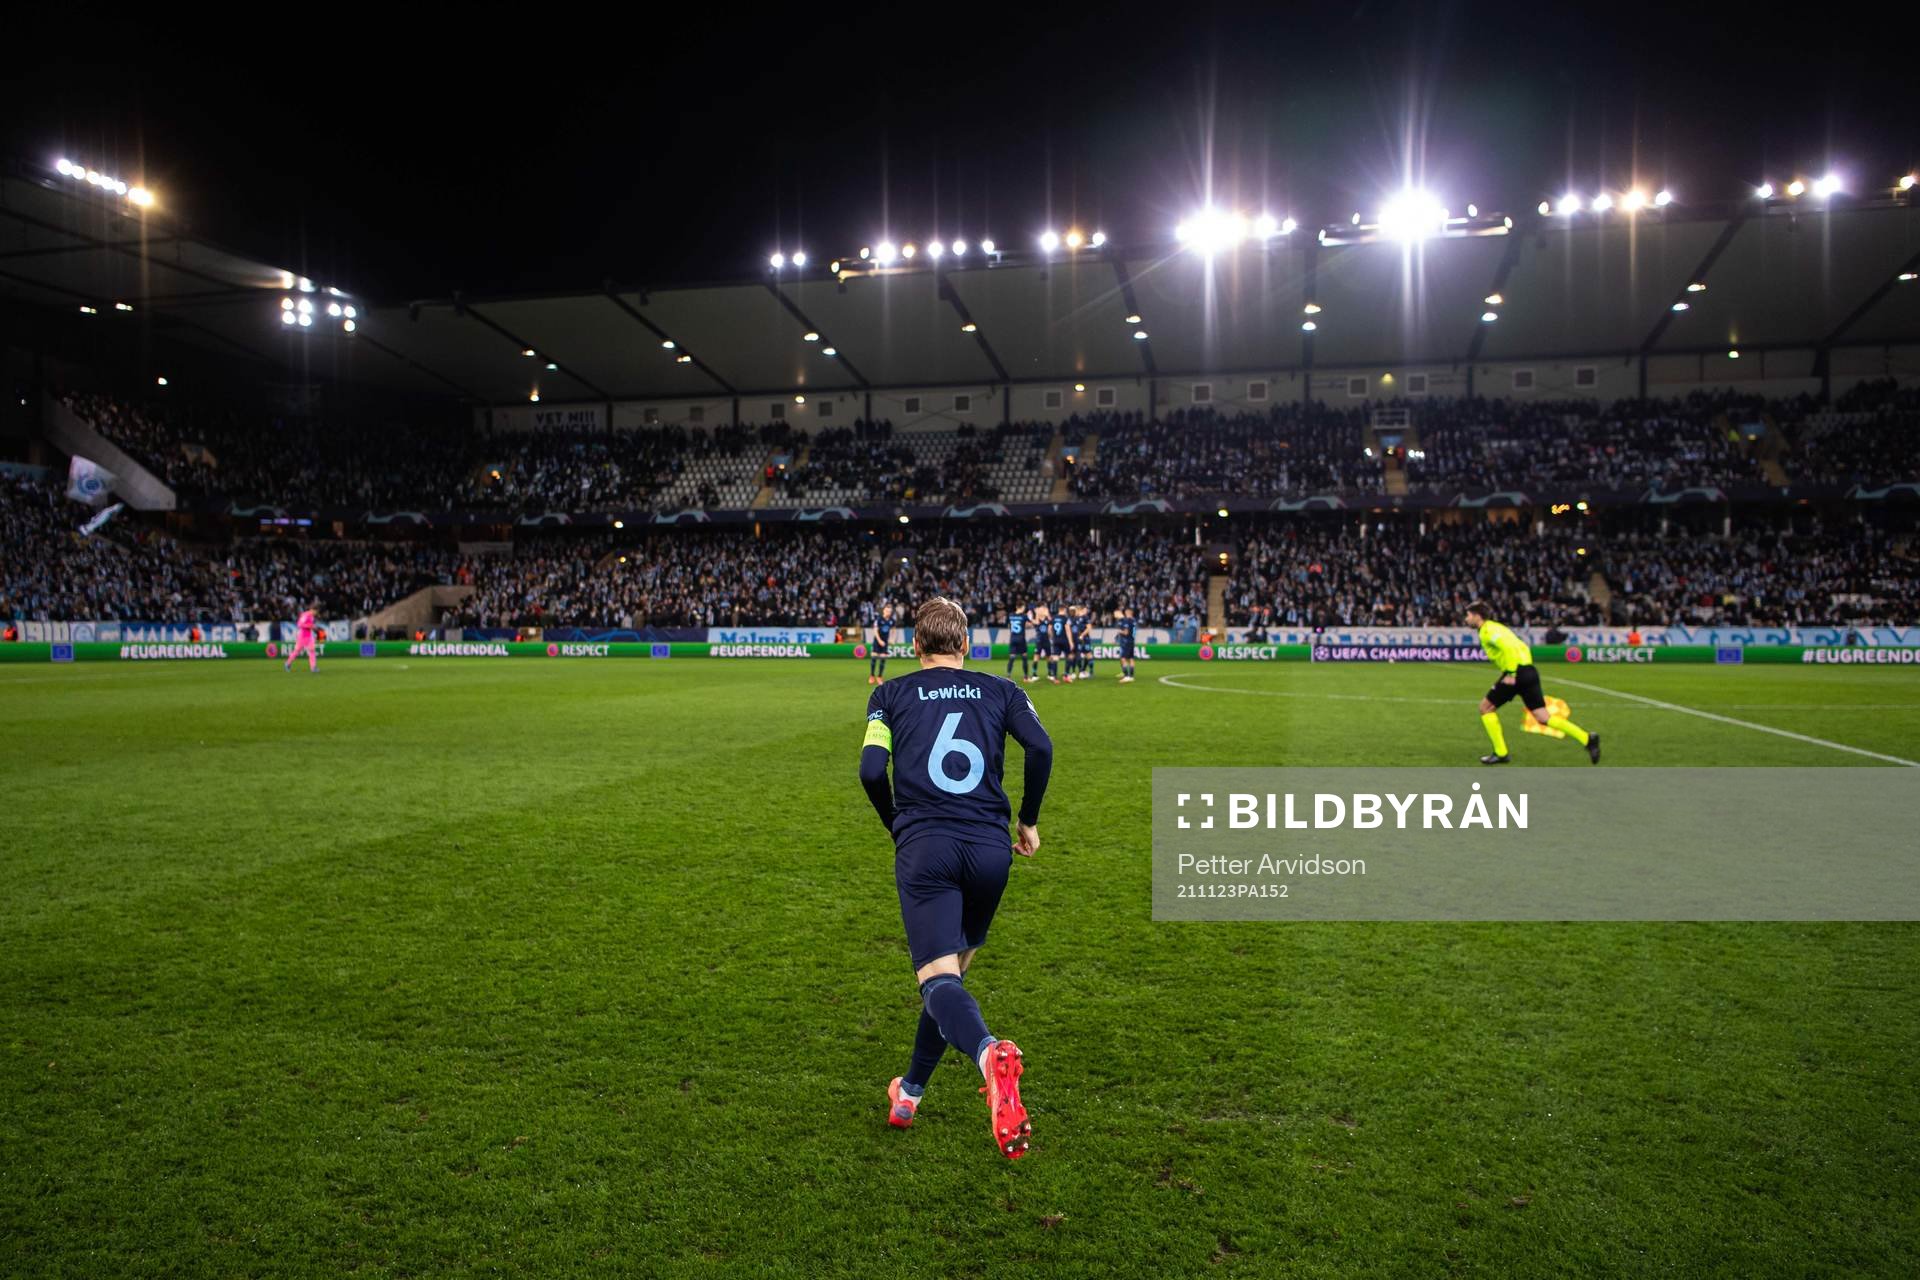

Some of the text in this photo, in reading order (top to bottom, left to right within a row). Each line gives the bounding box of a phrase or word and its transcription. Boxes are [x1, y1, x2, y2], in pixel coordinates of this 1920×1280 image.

[1010, 620, 1022, 634] 15
[1054, 622, 1063, 635] 9
[120, 644, 227, 659] #EUGREENDEAL
[409, 643, 509, 656] #EUGREENDEAL
[562, 645, 609, 657] RESPECT
[709, 645, 811, 657] #EUGREENDEAL
[1217, 647, 1278, 660] RESPECT
[1332, 648, 1367, 660] UEFA
[1370, 648, 1450, 661] CHAMPIONS
[1587, 647, 1656, 662] RESPECT
[917, 684, 982, 701] Lewicki
[927, 711, 985, 795] 6
